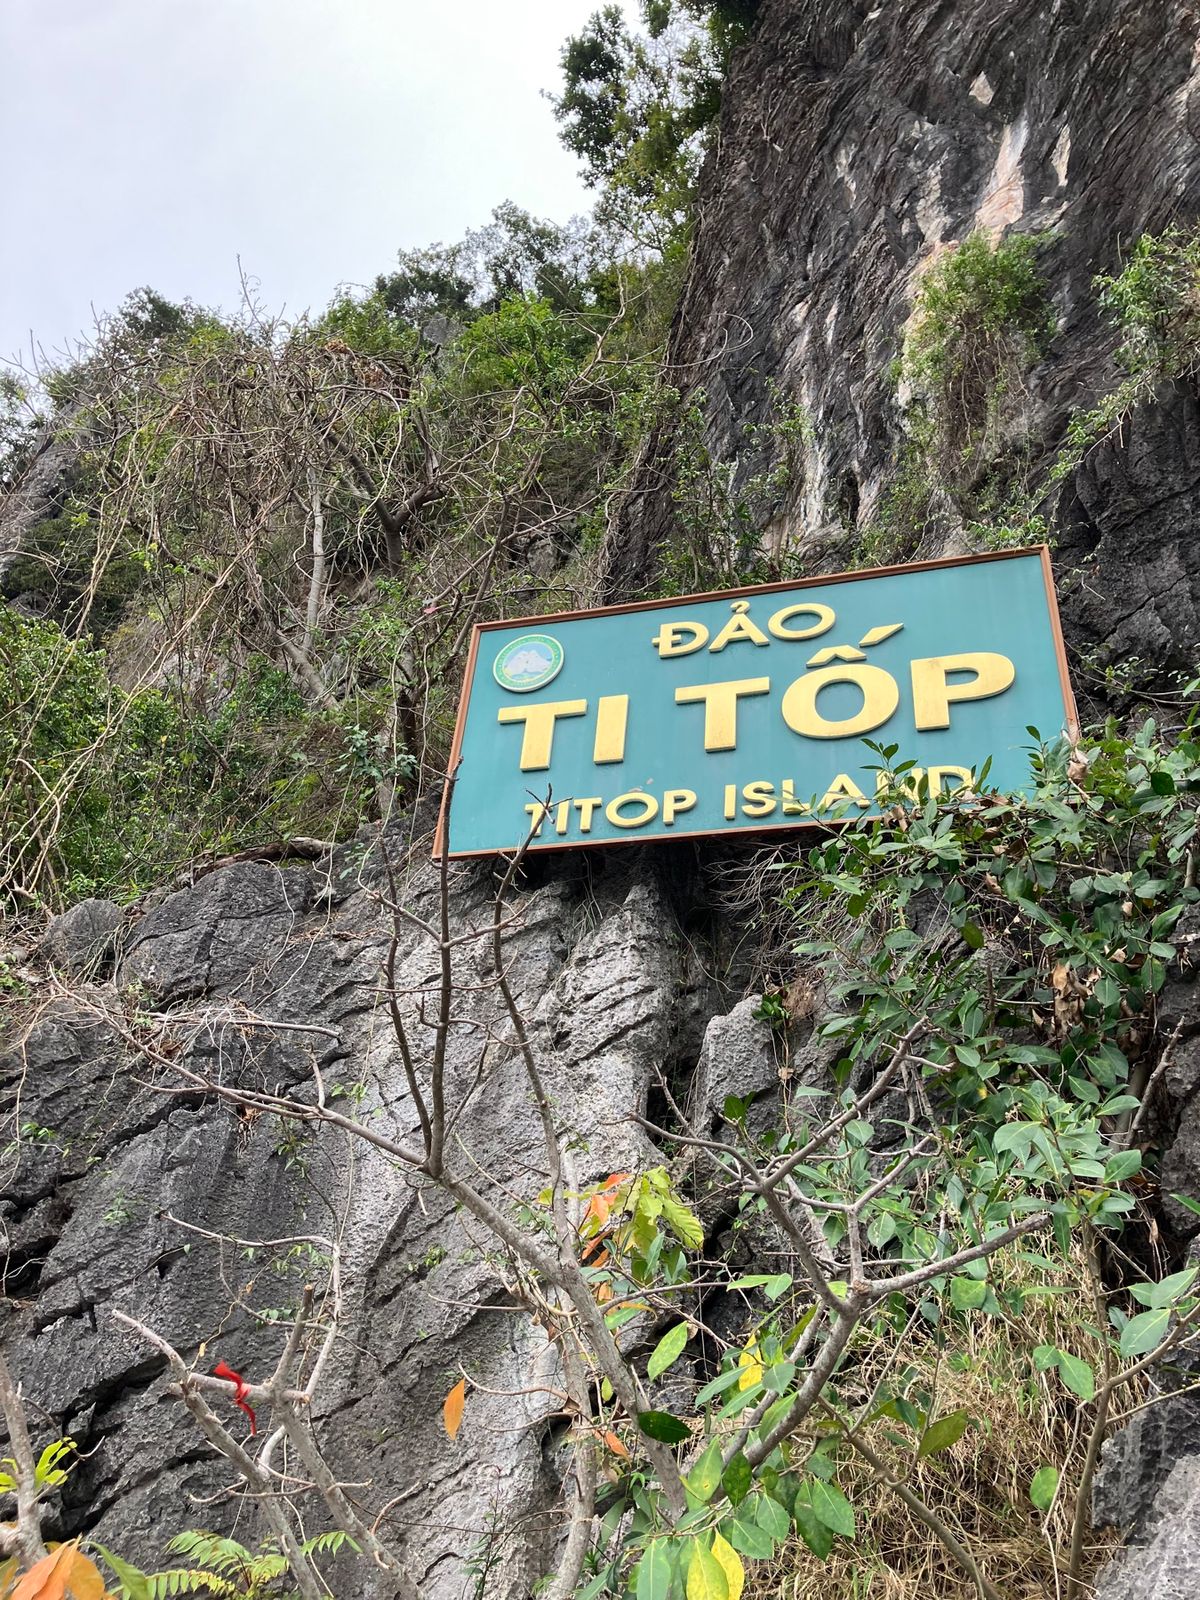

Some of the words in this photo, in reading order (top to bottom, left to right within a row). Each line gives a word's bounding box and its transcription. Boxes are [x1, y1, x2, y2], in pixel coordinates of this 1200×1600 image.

[653, 601, 836, 658] ĐẢO
[498, 694, 629, 771] TI
[675, 623, 1015, 752] TỐP
[525, 789, 697, 837] TITOP
